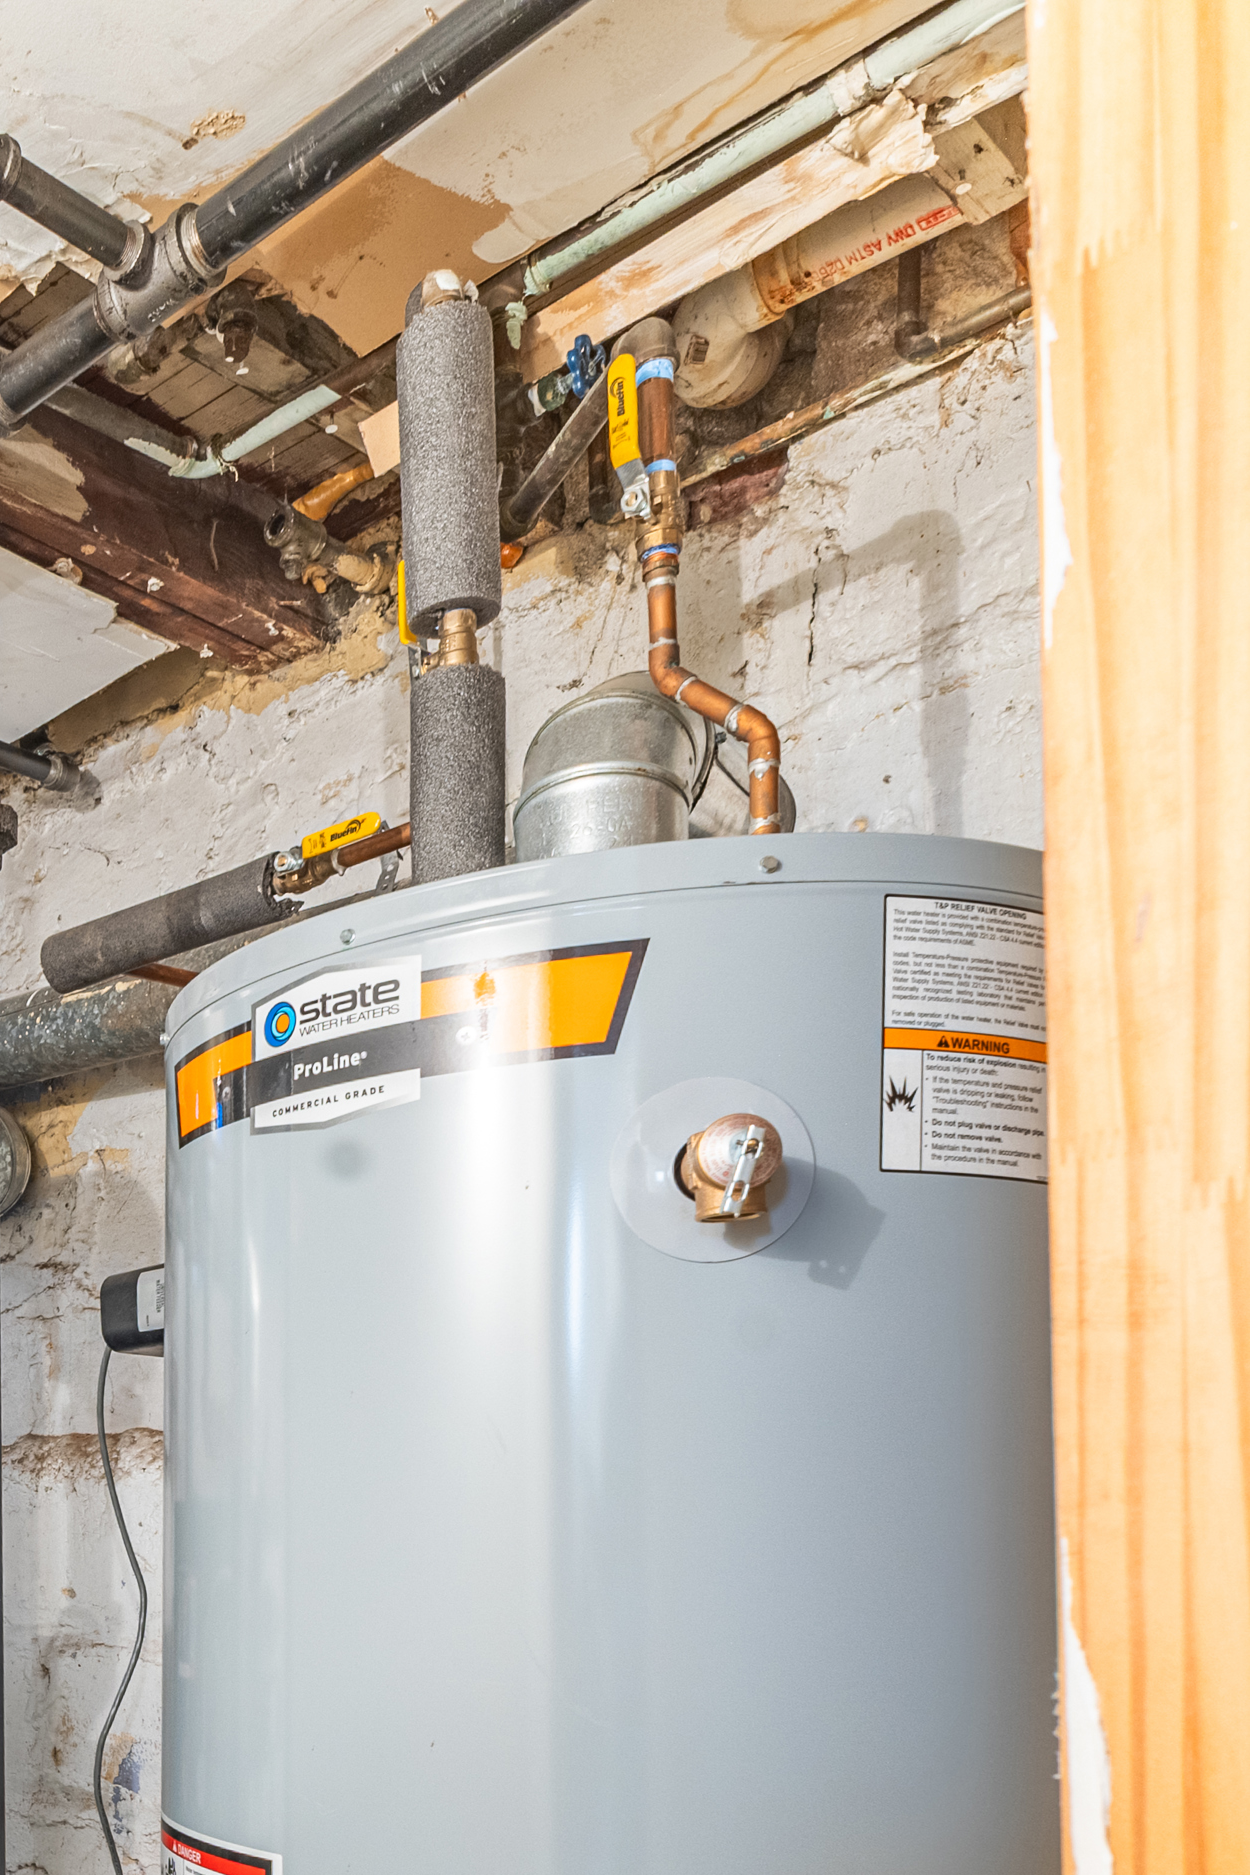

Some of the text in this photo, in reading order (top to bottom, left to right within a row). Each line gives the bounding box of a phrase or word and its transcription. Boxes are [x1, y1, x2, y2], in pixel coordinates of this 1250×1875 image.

[845, 223, 916, 265] DWV ASTM
[331, 827, 357, 842] BlueFin
[951, 903, 975, 911] RELIEF
[977, 905, 998, 915] VALVE
[999, 909, 1026, 919] OPENING
[300, 979, 400, 1024] state
[299, 1005, 400, 1036] WATER HEATERS
[951, 1037, 1010, 1054] WARNING
[272, 1085, 385, 1117] COMMERCIAL GRADE
[177, 1843, 201, 1864] DANGER
